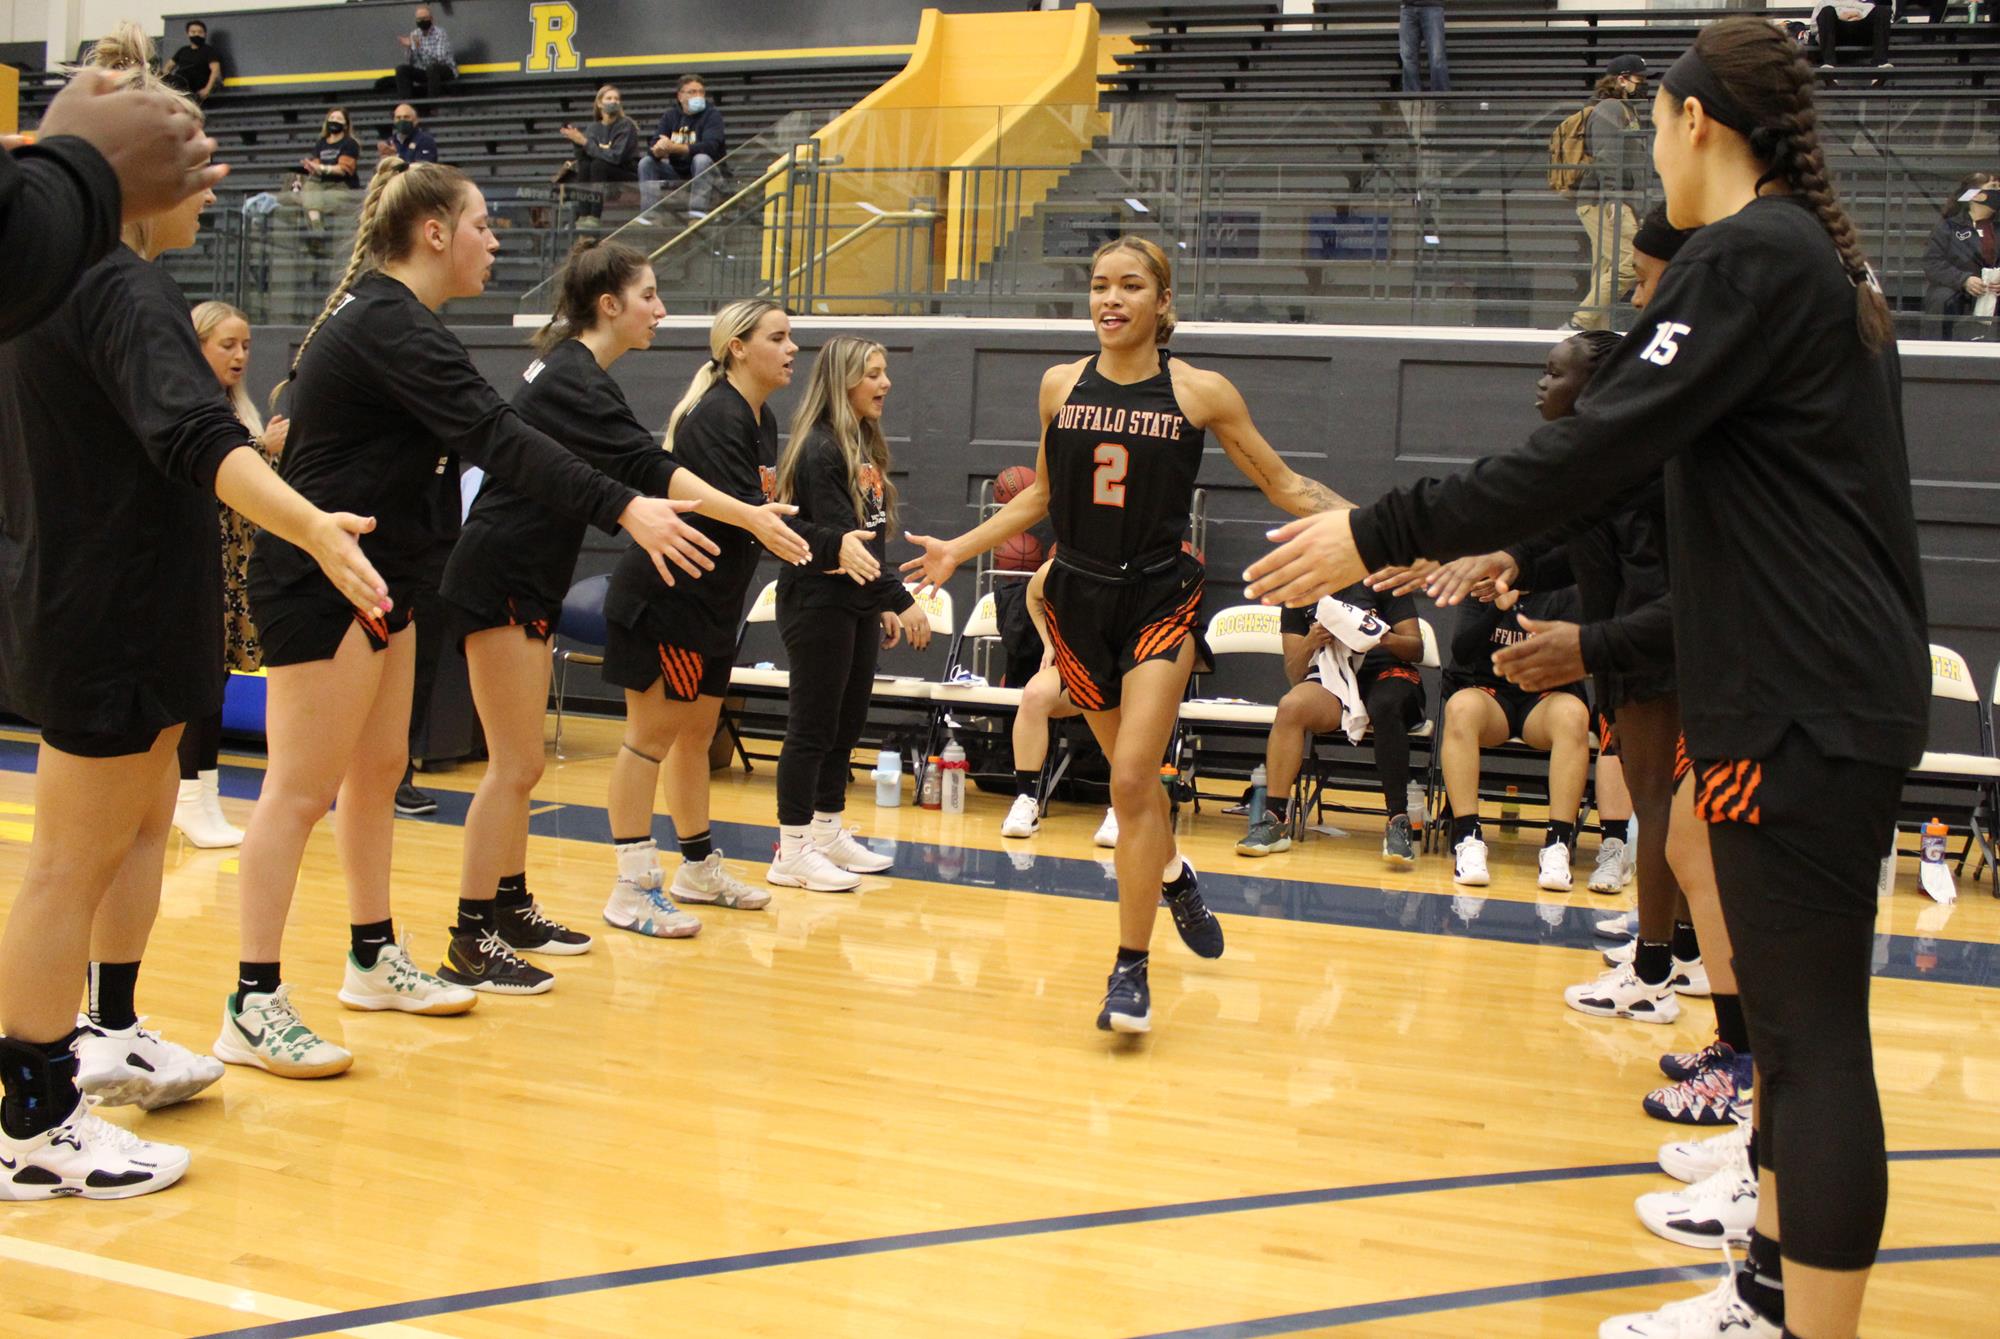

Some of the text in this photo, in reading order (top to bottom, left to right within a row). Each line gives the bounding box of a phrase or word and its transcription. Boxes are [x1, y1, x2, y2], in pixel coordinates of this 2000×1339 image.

[526, 1, 580, 74] R
[1640, 321, 1692, 366] 15
[1057, 404, 1183, 440] BUFFALO STATE
[1093, 442, 1129, 508] 2
[1215, 613, 1281, 637] ROCHEST
